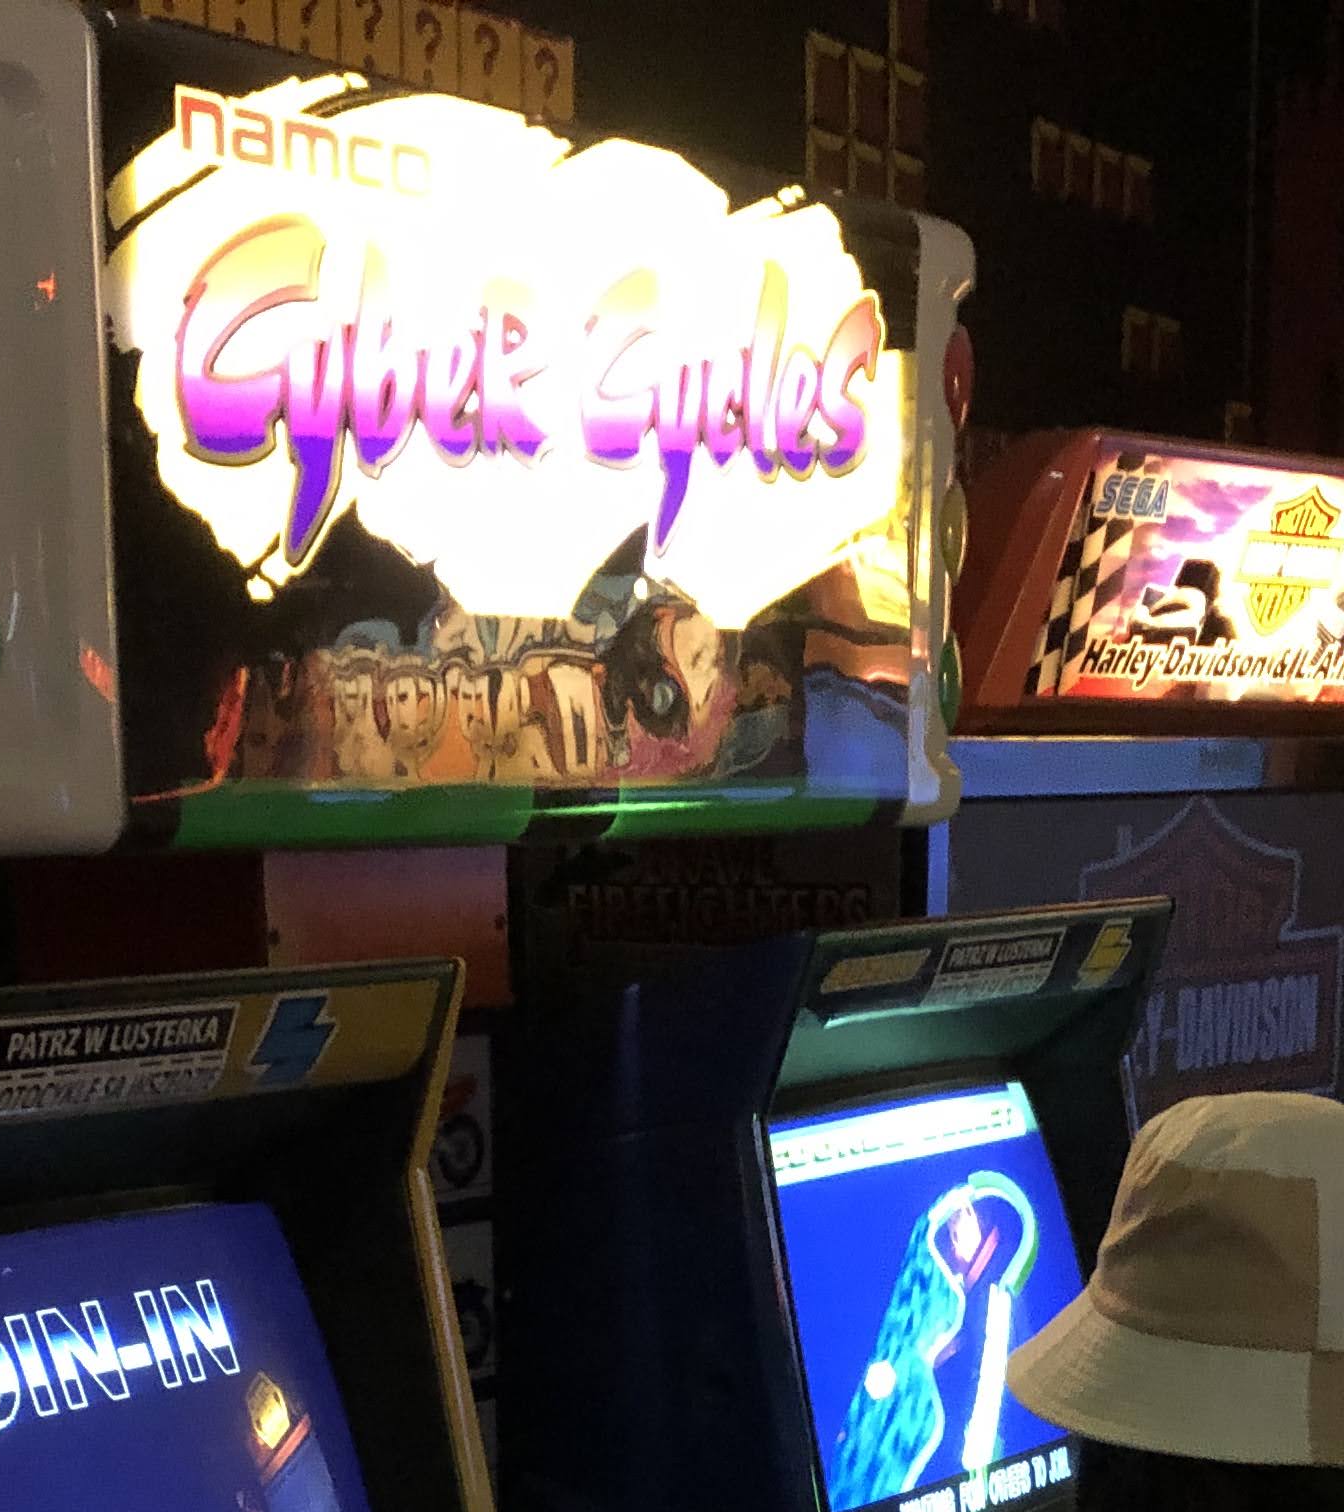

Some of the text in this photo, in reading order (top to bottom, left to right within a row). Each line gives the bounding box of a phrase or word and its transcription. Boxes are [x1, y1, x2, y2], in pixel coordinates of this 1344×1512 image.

[179, 95, 433, 198] namco
[1095, 473, 1170, 523] SEGA
[1078, 636, 1267, 690] Harley-Davidson
[6, 1014, 219, 1065] PATRZ W LUSTERKA
